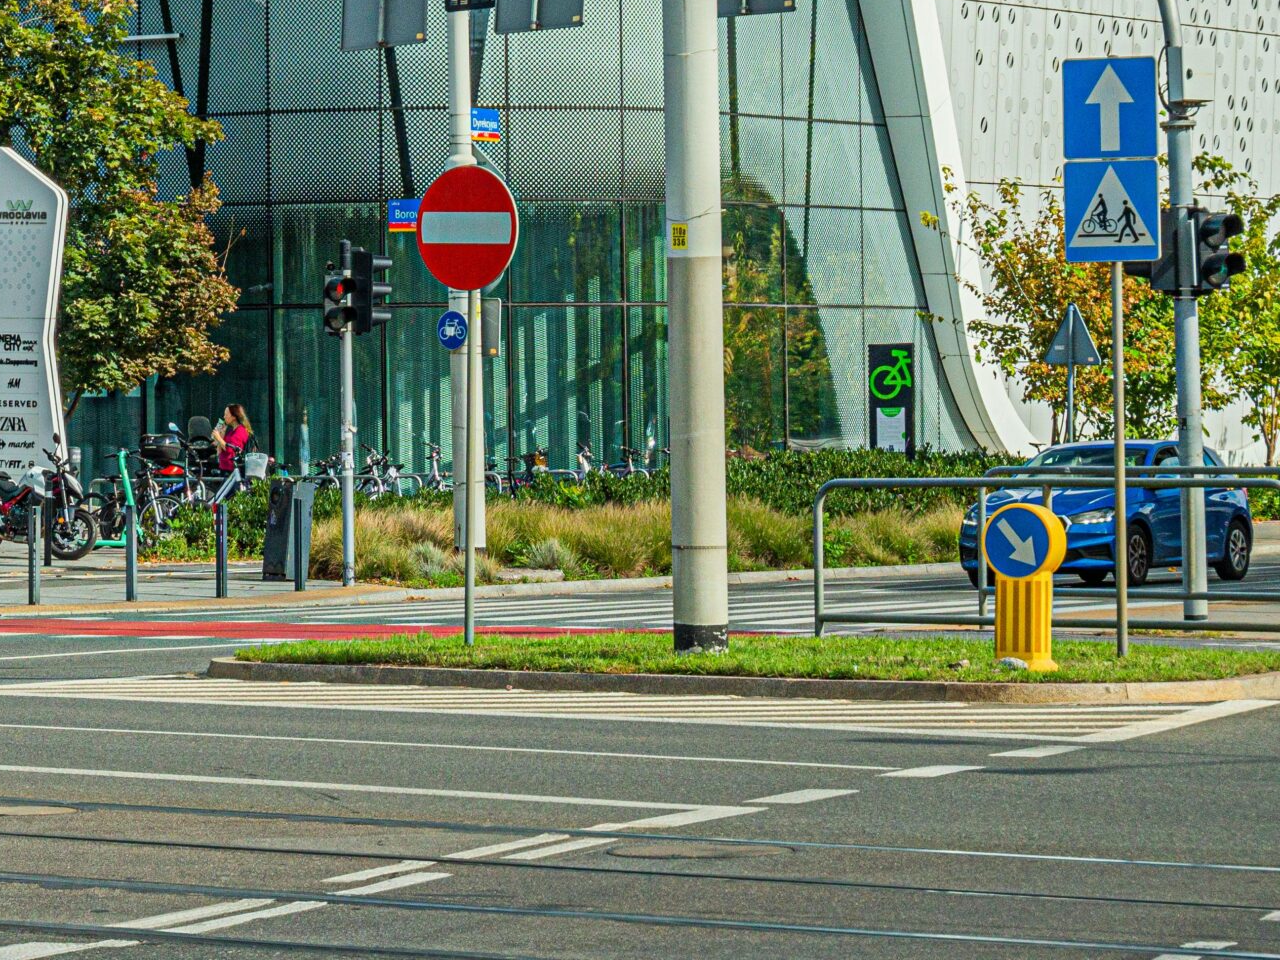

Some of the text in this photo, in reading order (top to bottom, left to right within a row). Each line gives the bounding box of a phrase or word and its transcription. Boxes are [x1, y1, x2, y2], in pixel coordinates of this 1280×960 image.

[672, 238, 686, 246] 336
[3, 342, 22, 351] CITY
[0, 416, 27, 432] ZARA
[7, 440, 35, 449] market
